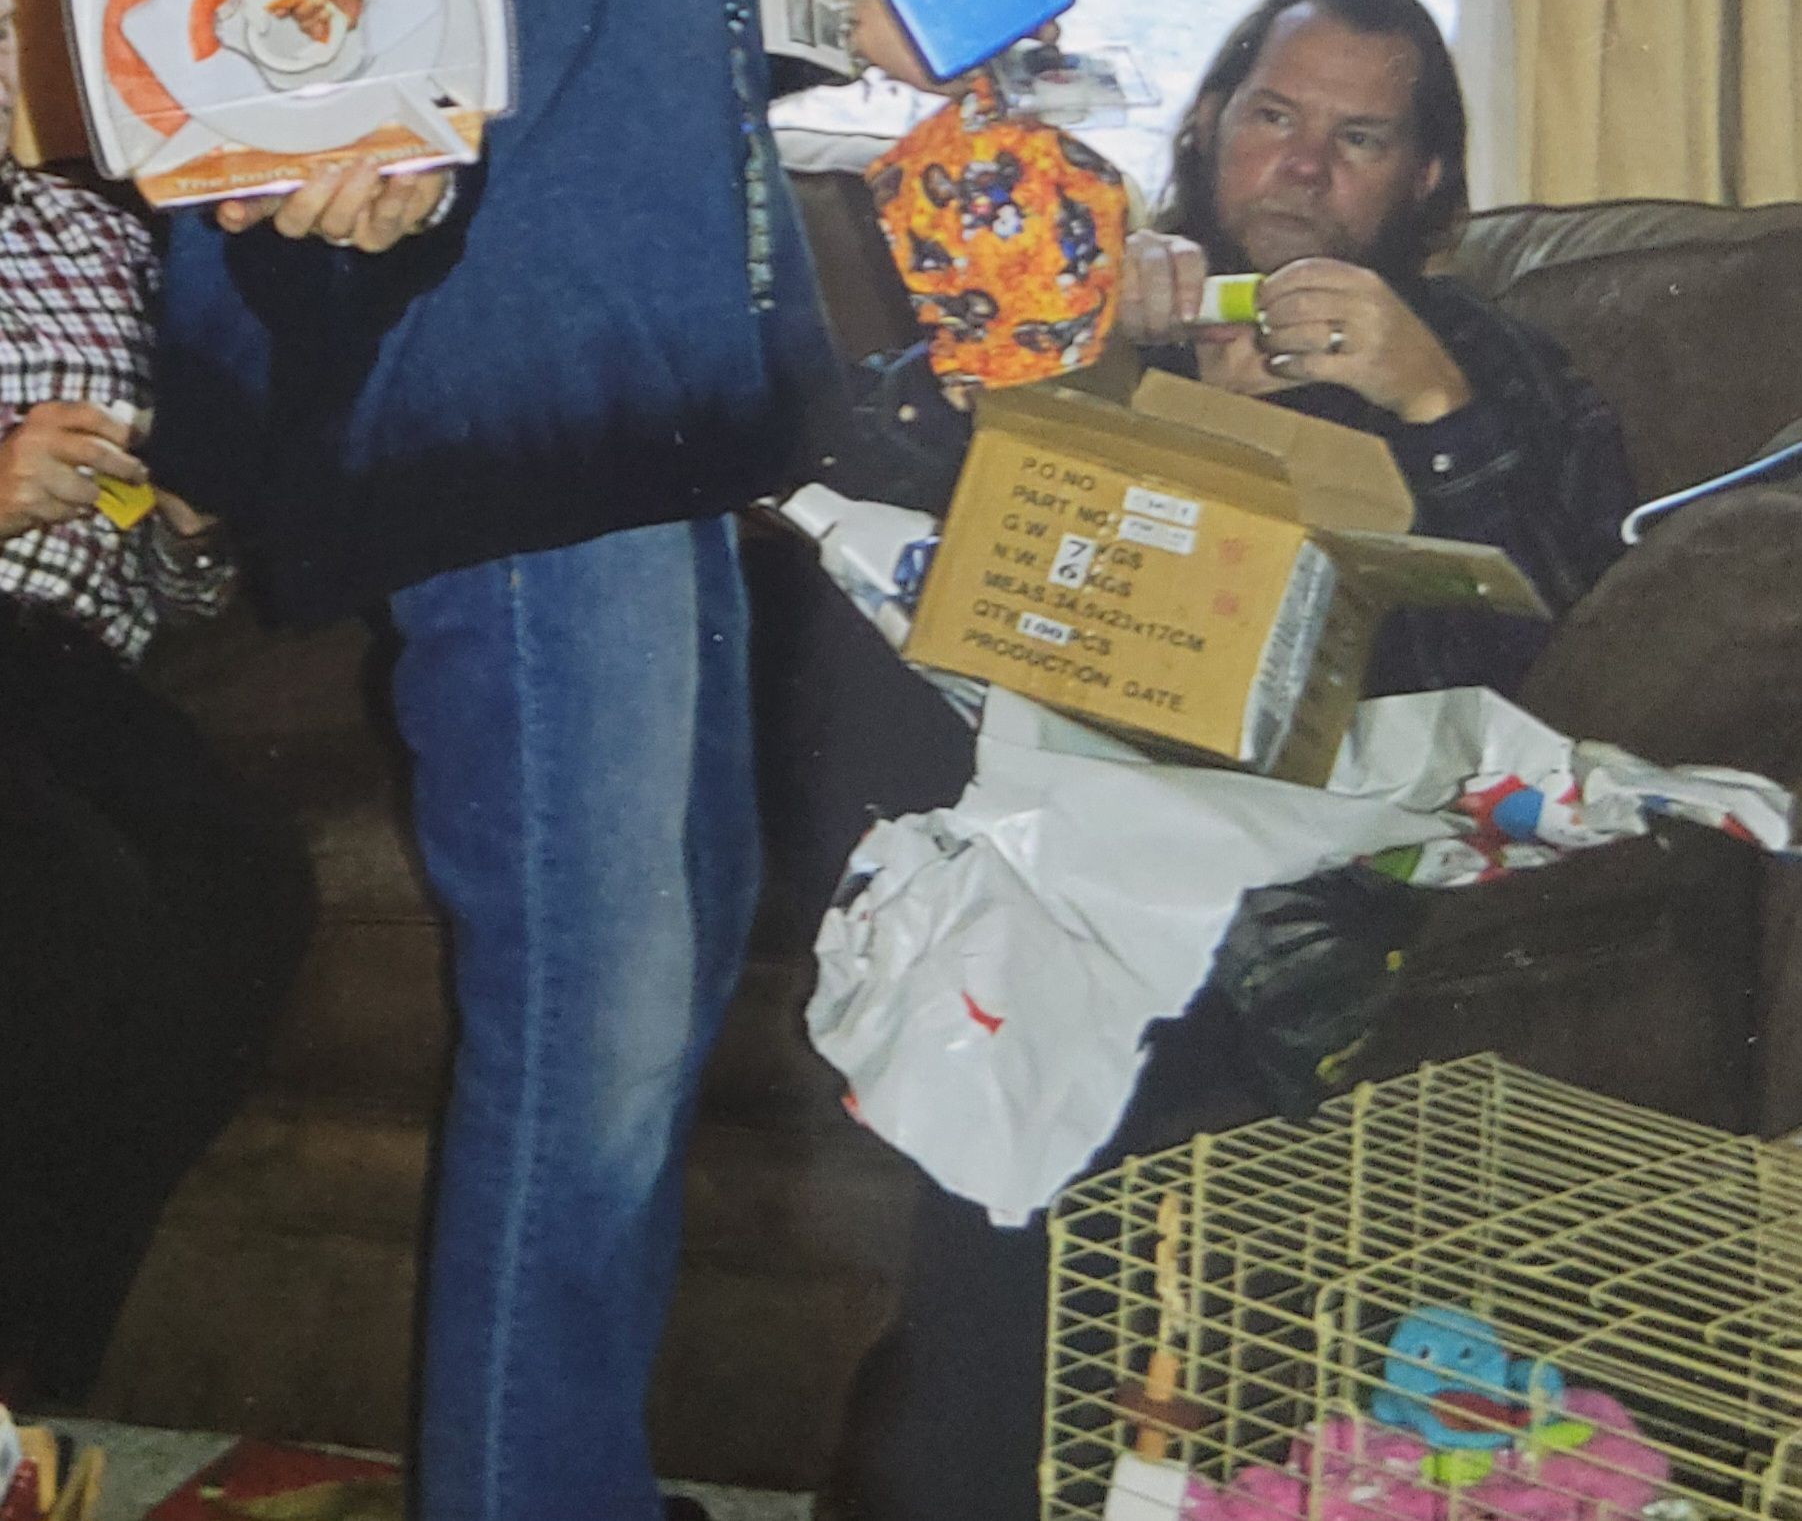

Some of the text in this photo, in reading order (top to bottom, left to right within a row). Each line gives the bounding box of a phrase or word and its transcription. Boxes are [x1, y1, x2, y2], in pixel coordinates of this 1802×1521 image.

[1012, 484, 1071, 514] PART
[1067, 540, 1089, 558] 7
[1057, 562, 1081, 580] 6
[962, 628, 1112, 688] PRODUCTION
